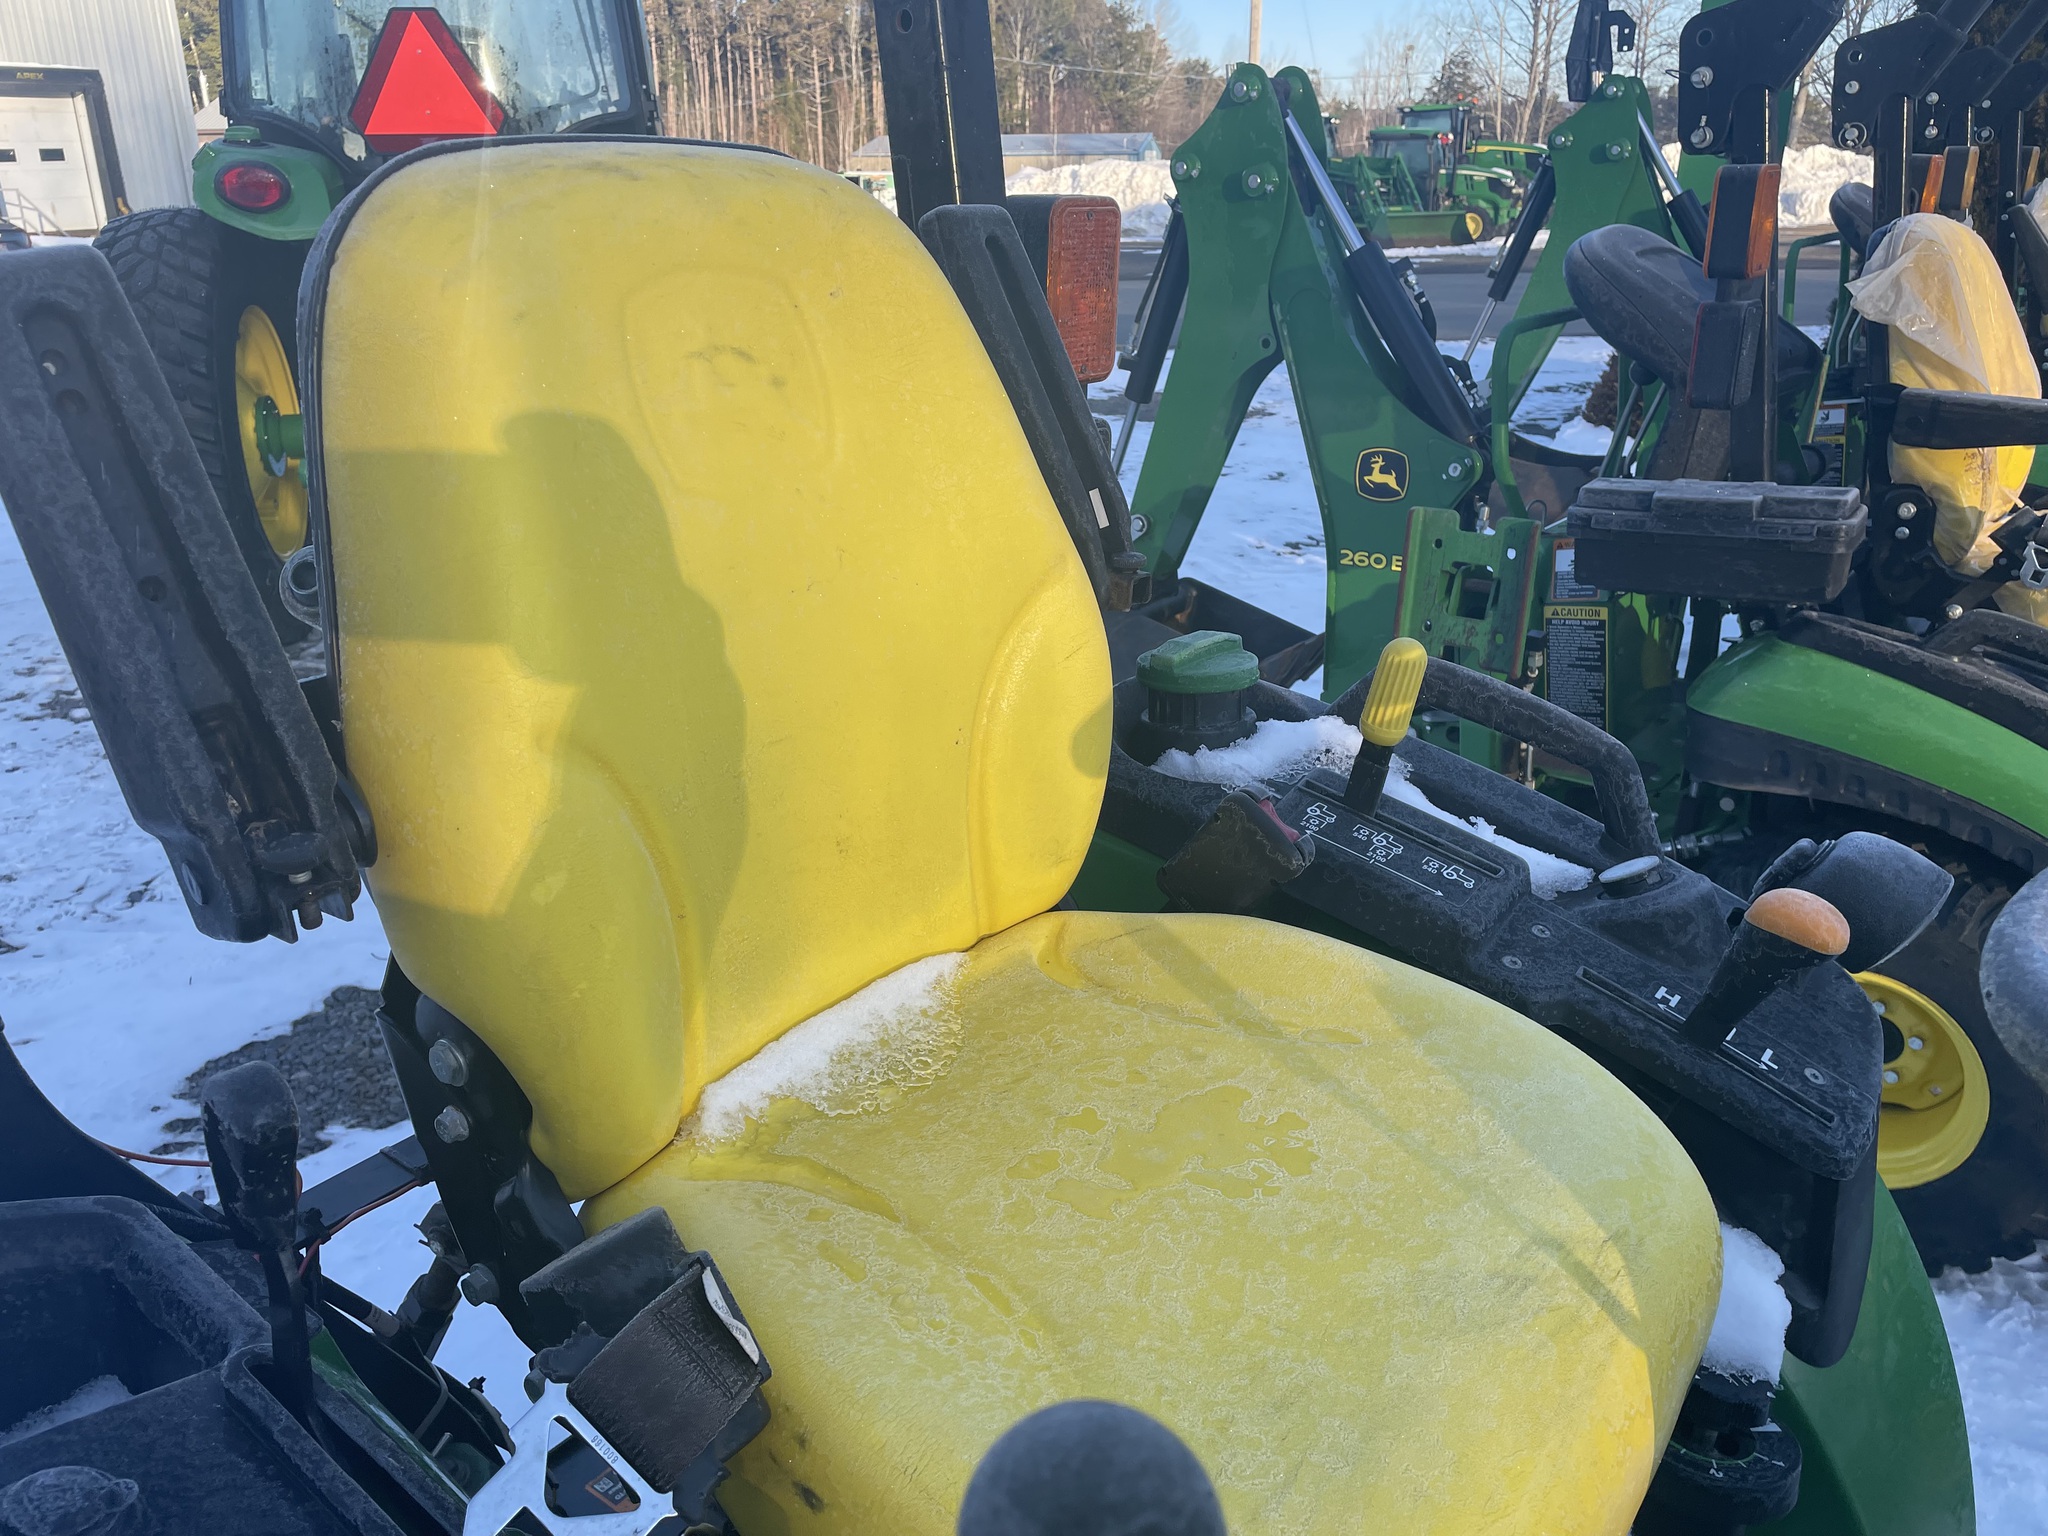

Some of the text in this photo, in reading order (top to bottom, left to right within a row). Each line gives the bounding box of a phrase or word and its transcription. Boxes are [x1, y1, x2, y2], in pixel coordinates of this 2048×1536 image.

[16, 72, 44, 80] APEX
[1340, 549, 1403, 572] 260 E
[1561, 607, 1600, 618] CAUTION
[1300, 821, 1319, 832] 2100
[1352, 832, 1368, 841] 540
[1366, 851, 1386, 863] 2100
[1422, 865, 1438, 874] 540
[1654, 985, 1682, 1008] H
[1760, 1048, 1779, 1070] L
